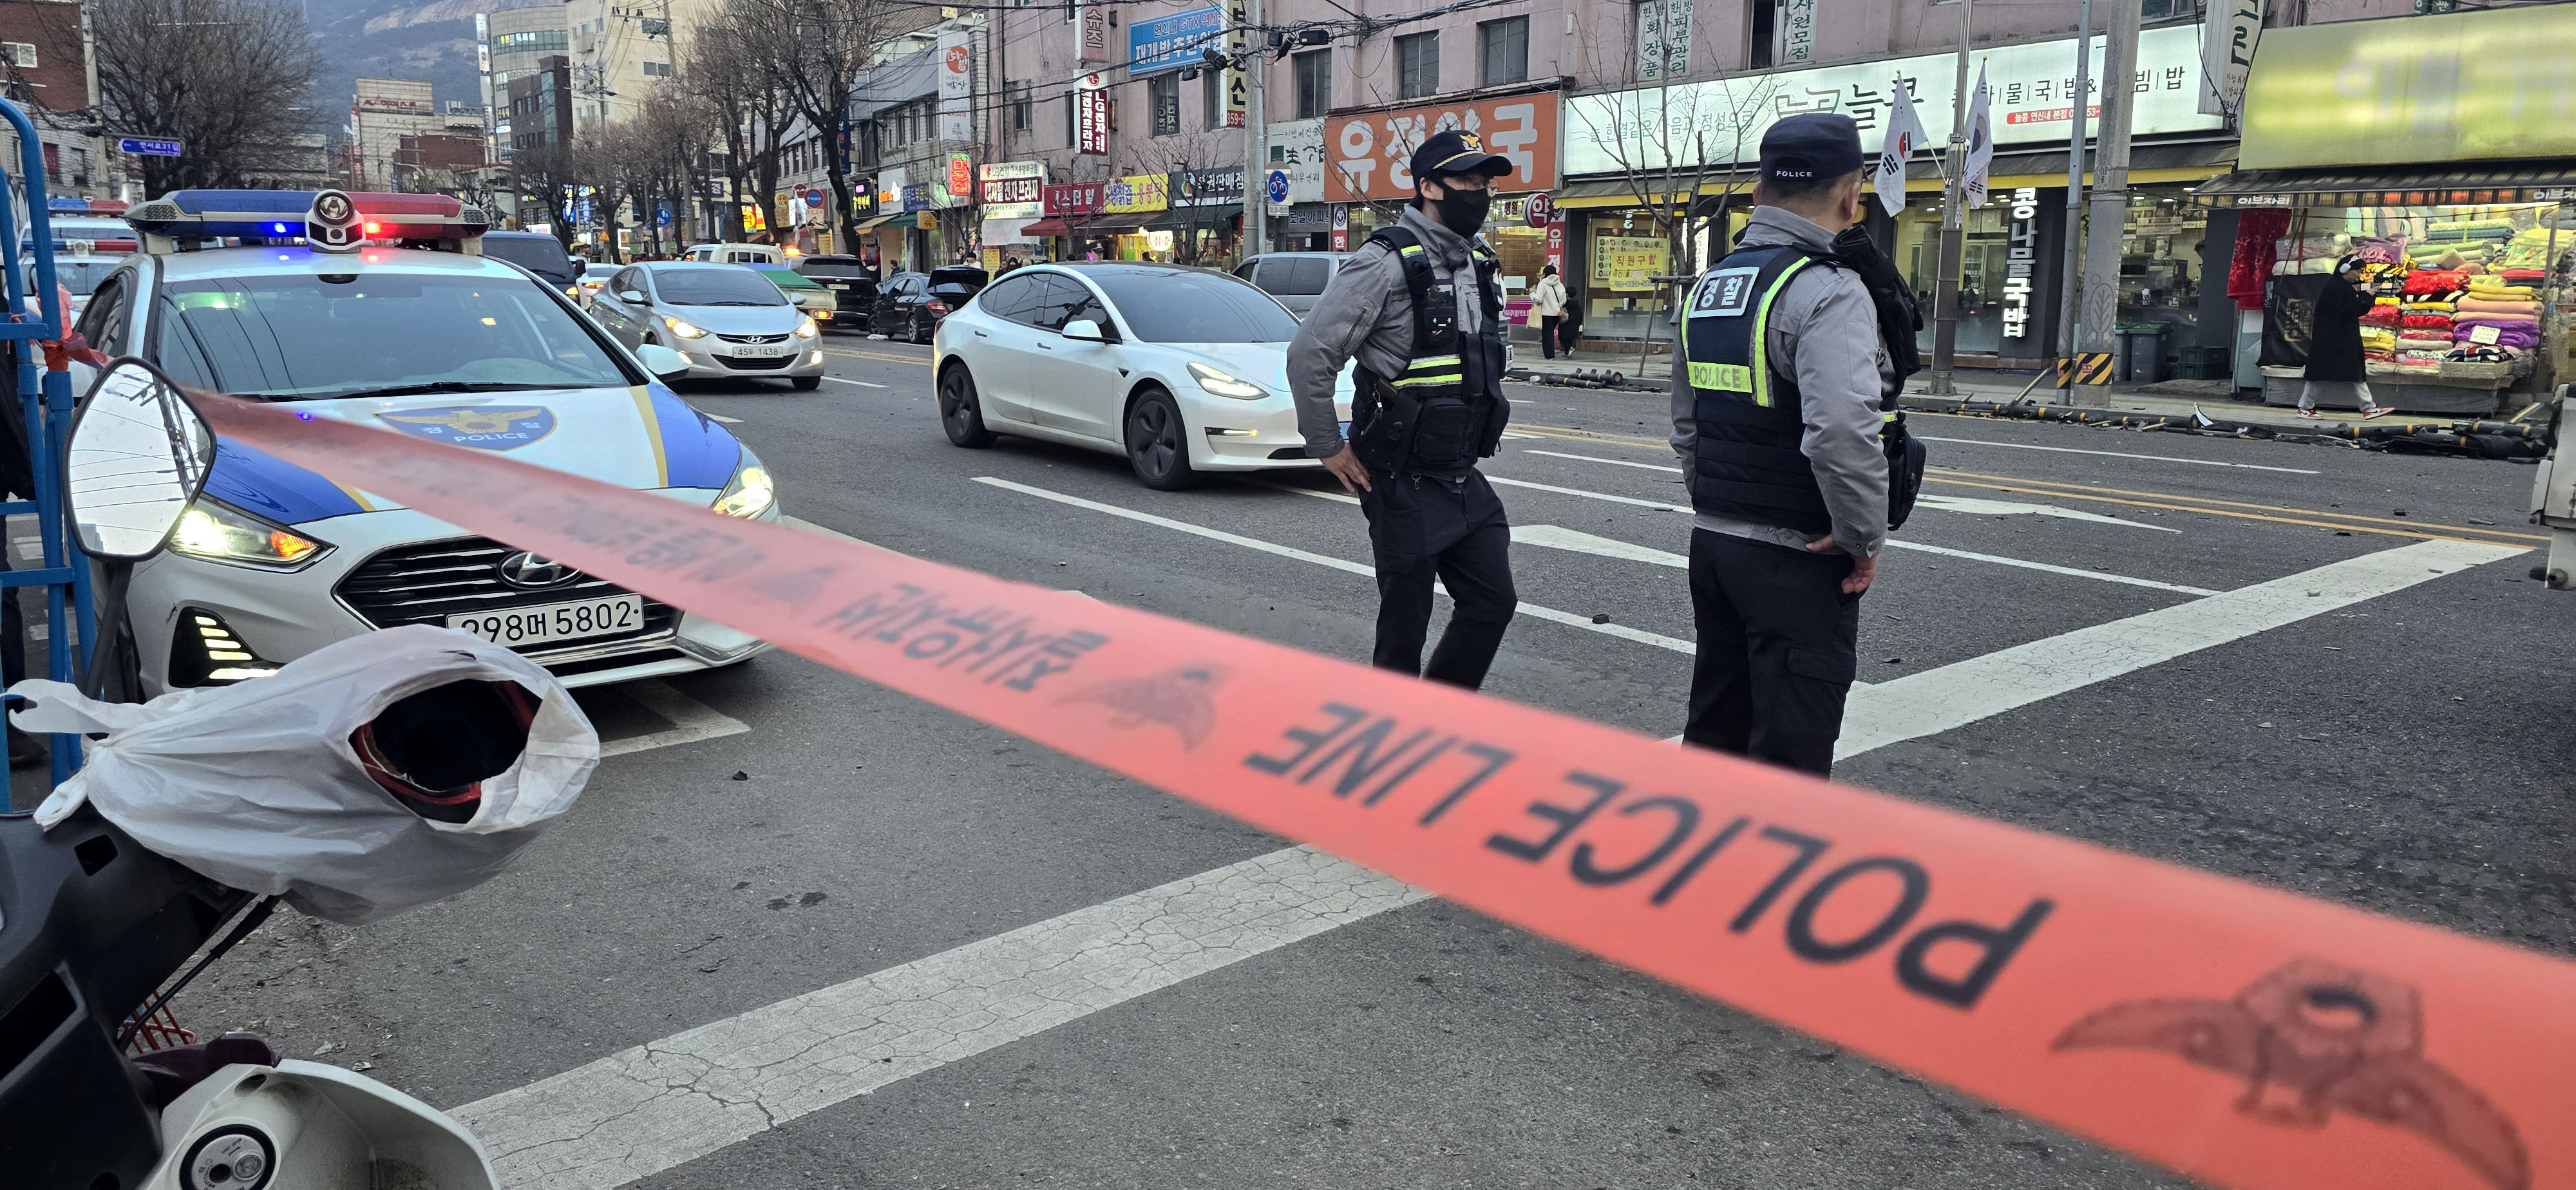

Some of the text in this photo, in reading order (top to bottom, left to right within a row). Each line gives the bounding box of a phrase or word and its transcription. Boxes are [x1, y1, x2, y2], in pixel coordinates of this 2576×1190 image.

[1154, 19, 1178, 37] 연신내
[1180, 15, 1200, 30] GTX
[1643, 19, 1661, 77] 화장품
[1671, 15, 1689, 73] 피부관리
[1095, 91, 1105, 133] LG전자
[2031, 111, 2051, 121] 연신내
[2053, 109, 2067, 120] 본점
[1533, 198, 1550, 224] 약
[2237, 195, 2290, 205] 이브자리
[2003, 187, 2038, 337] 콩나물국밥
[1700, 276, 1744, 308] 경찰
[1694, 365, 1741, 389] POLICE
[453, 432, 529, 443] POLICE
[556, 601, 632, 636] 5802
[1243, 700, 2058, 1011] POLICE LINE
